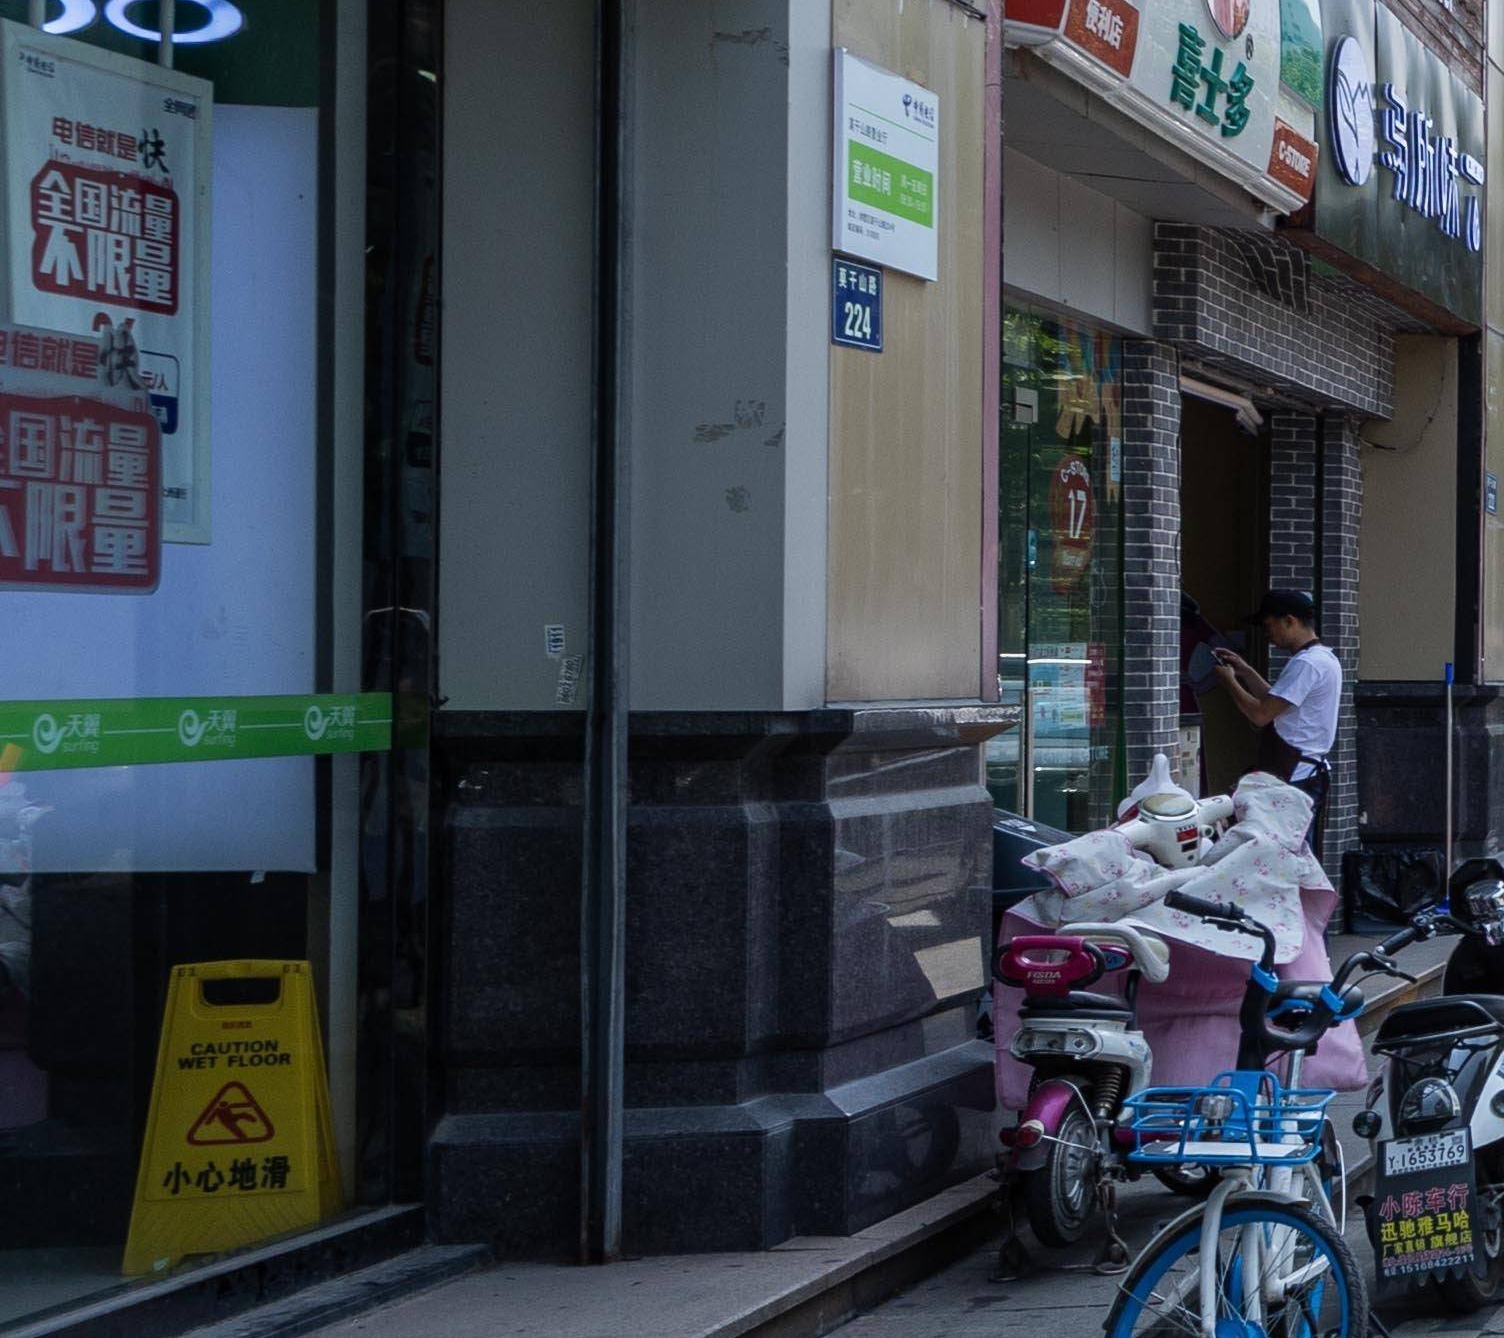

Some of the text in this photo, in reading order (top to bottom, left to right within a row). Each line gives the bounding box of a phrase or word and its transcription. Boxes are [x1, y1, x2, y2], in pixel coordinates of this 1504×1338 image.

[1169, 20, 1254, 139] 喜士多
[52, 115, 169, 174] 电信就是快
[1277, 133, 1311, 179] C-STORE
[38, 170, 173, 244] 全国流量
[38, 217, 173, 307] 不限量
[837, 267, 878, 296] 莫干山路
[844, 301, 872, 340] 224
[0, 410, 149, 490] 国流量
[1067, 489, 1088, 539] 17
[63, 713, 100, 738] 天翼
[206, 709, 238, 733] 天翼
[328, 705, 356, 728] 天翼
[177, 1053, 292, 1070] WET FLOOR
[190, 1039, 279, 1056] CAUTION
[162, 1155, 291, 1195] 小心地滑
[1379, 1183, 1470, 1222] 小陈车行
[1380, 1209, 1470, 1243] 迅驰雅马哈
